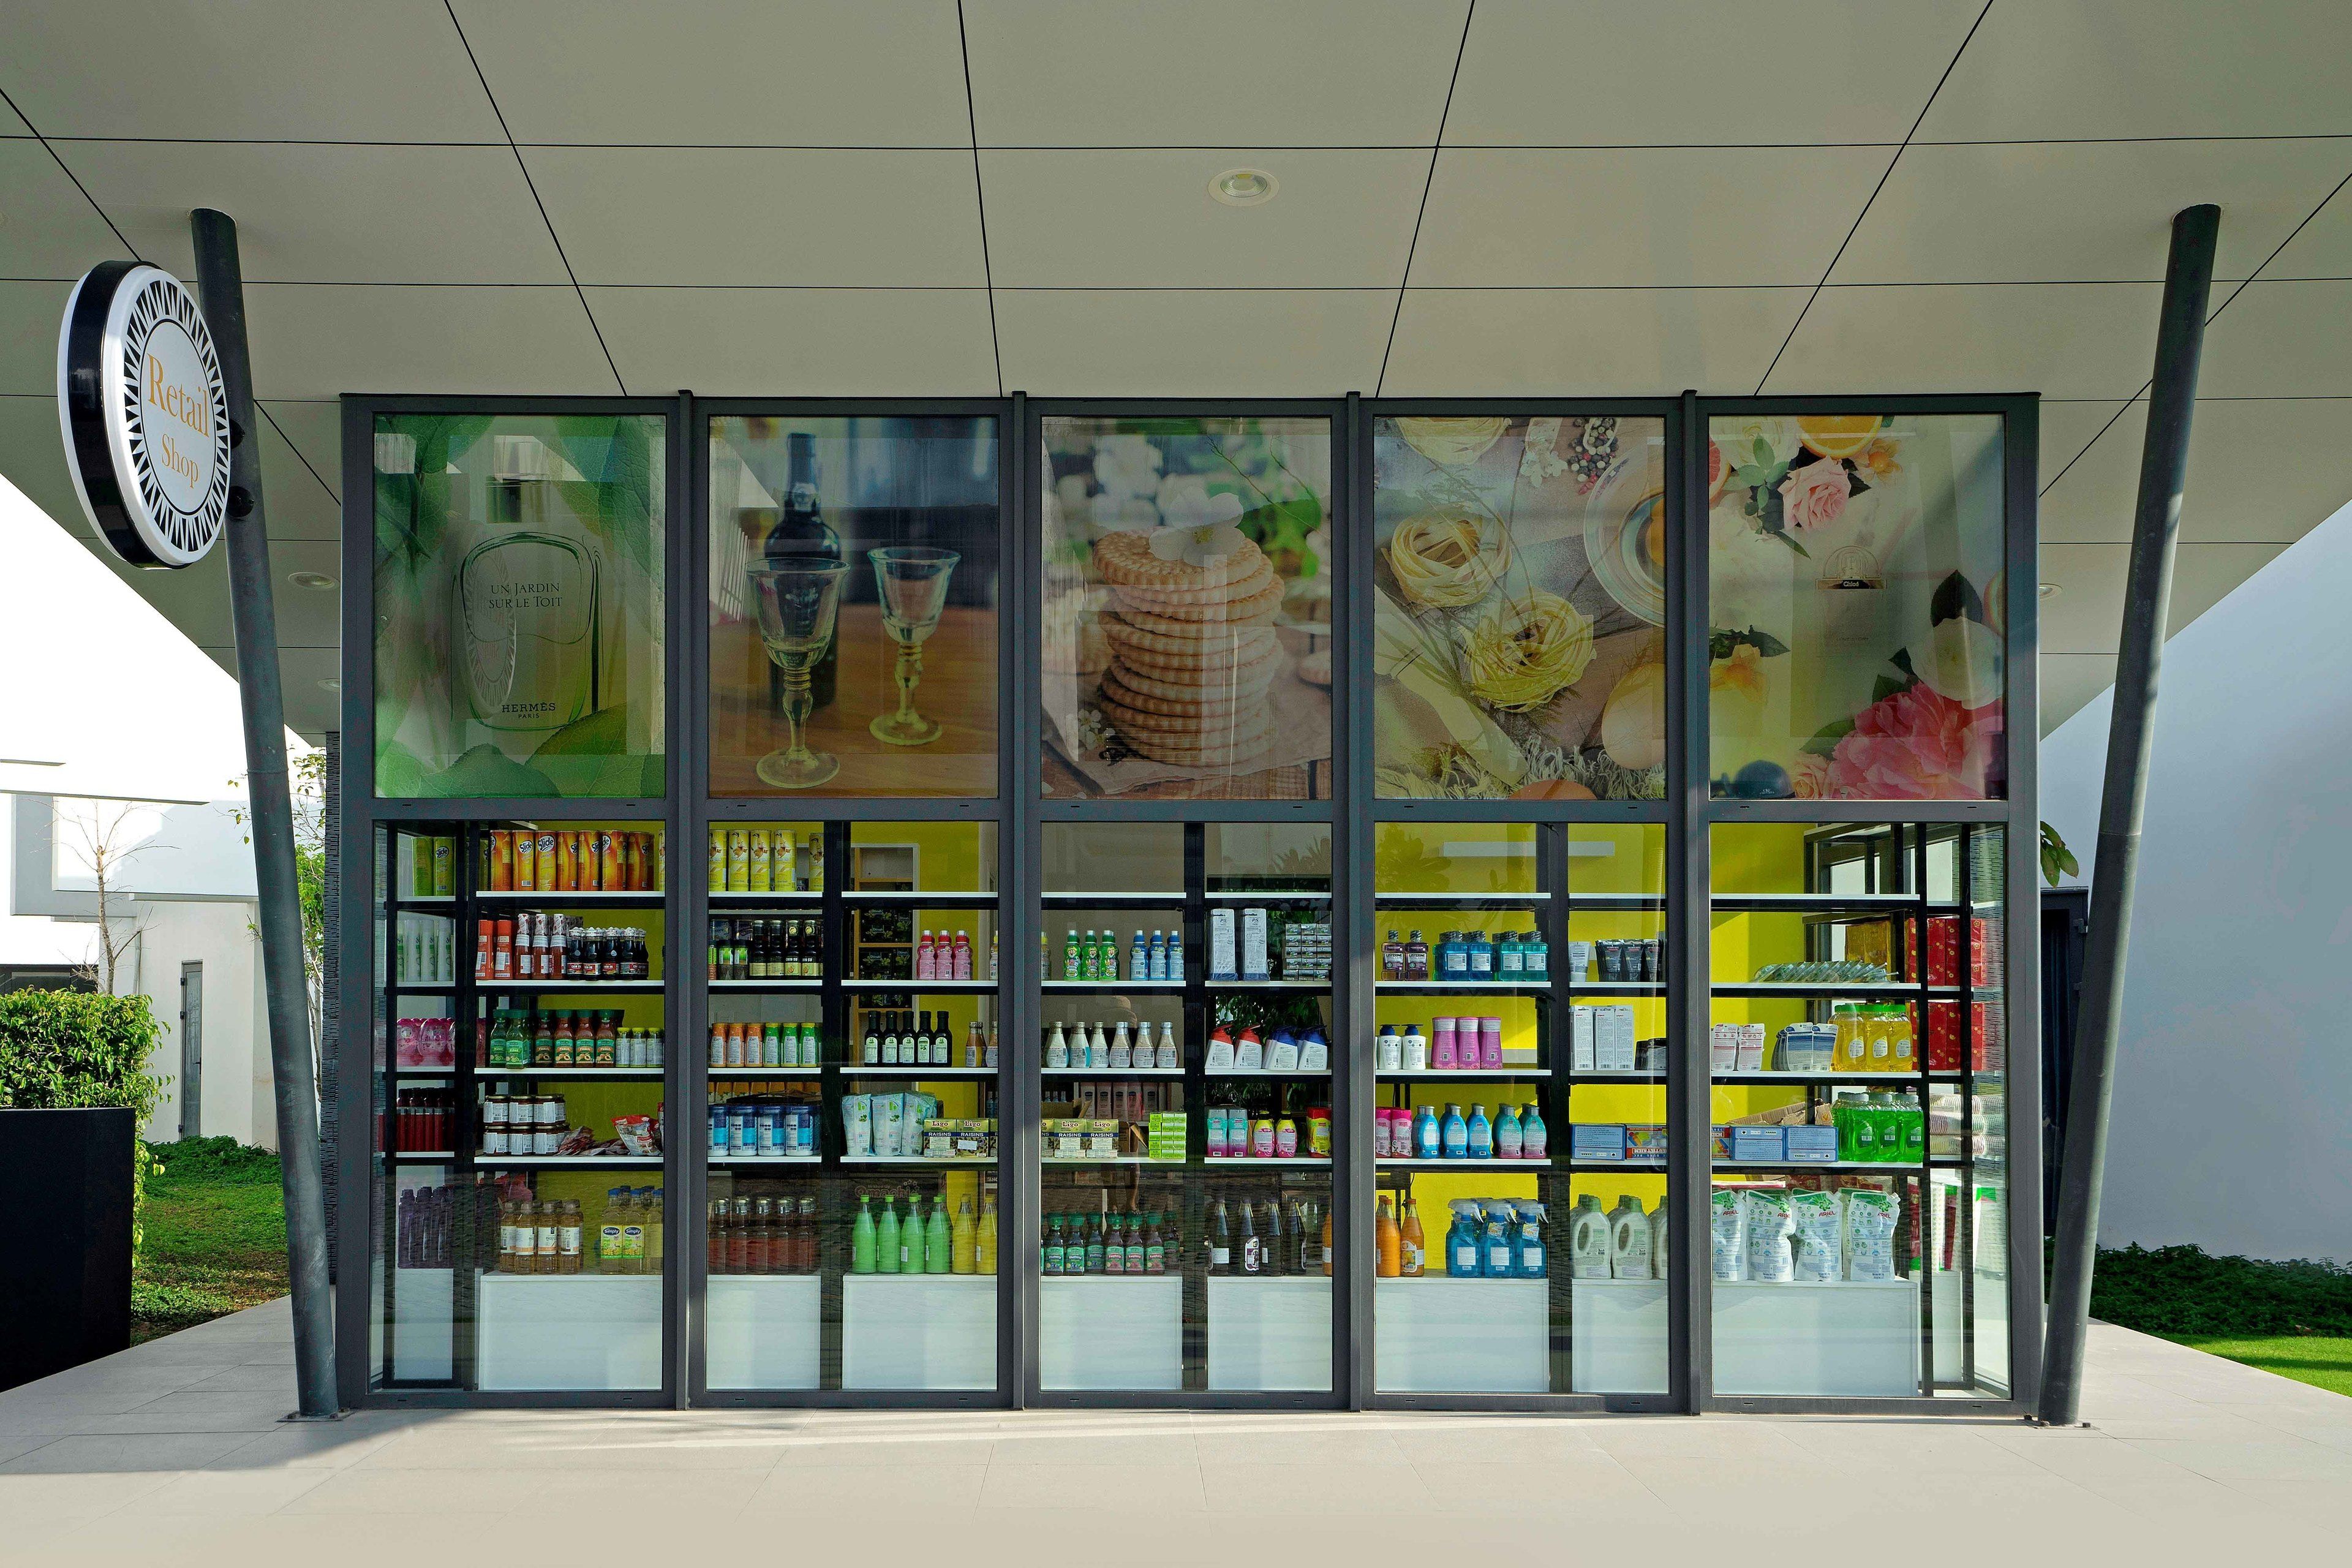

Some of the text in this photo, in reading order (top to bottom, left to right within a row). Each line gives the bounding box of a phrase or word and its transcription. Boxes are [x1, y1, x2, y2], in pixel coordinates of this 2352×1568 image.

[148, 353, 209, 439] Retail
[162, 434, 199, 489] Shop
[491, 582, 560, 597] UN JARDIN
[489, 596, 563, 609] SUR LE TOIT
[519, 841, 532, 852] Slide
[538, 836, 554, 851] Slide
